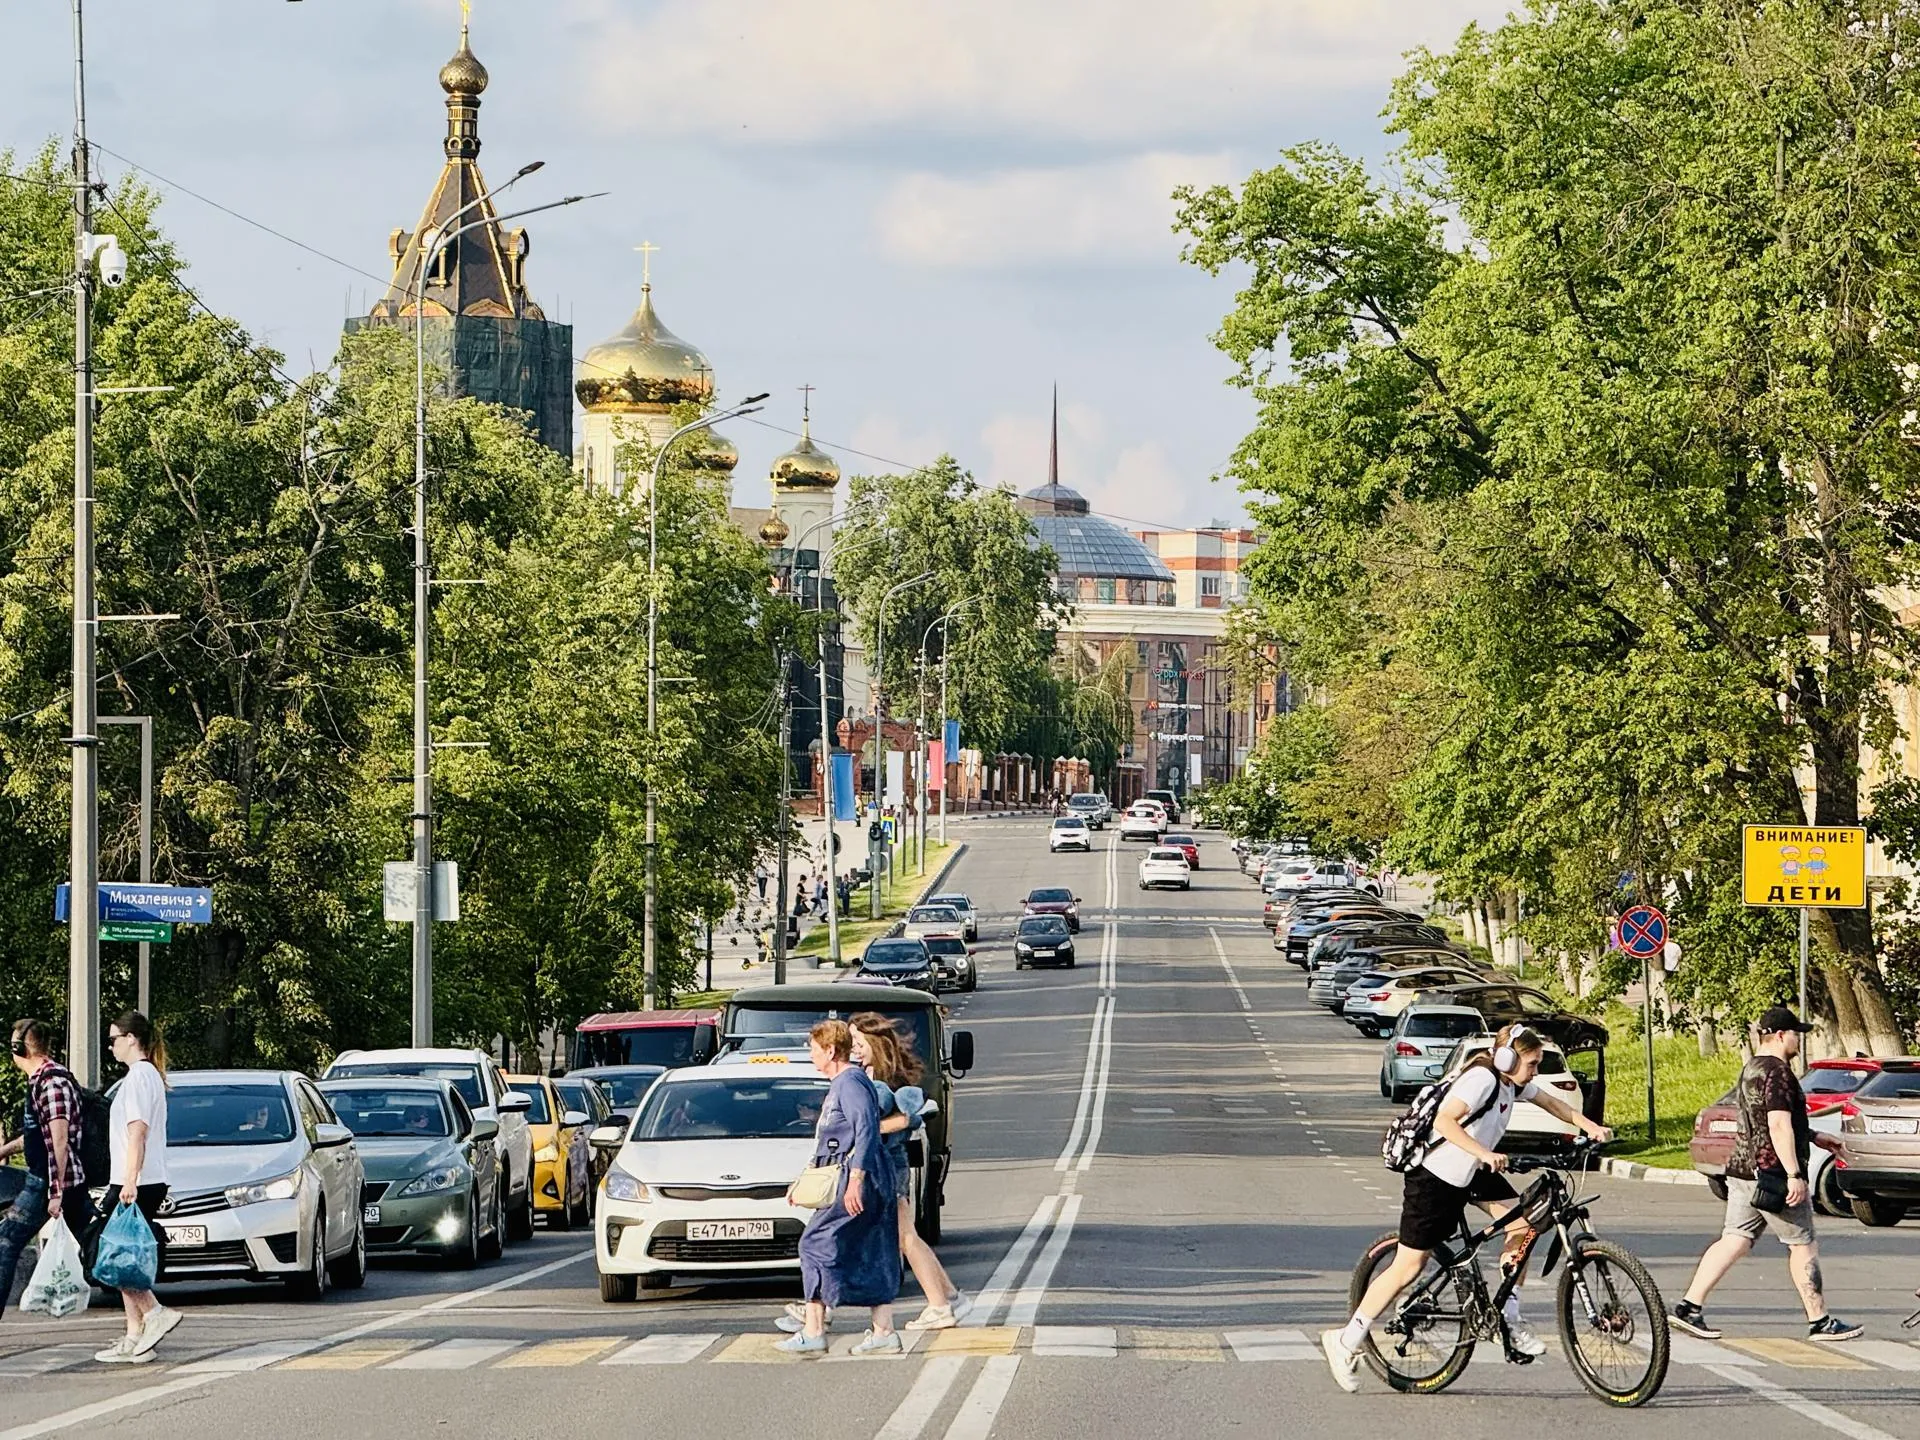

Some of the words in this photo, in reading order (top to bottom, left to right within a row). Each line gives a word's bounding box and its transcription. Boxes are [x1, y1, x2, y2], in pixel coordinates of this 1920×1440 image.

[1756, 830, 1854, 843] ВНИМАНИЕ!
[109, 891, 193, 906] Михалевича
[1767, 886, 1841, 902] ДЕТИ
[160, 909, 191, 919] улица
[181, 1228, 201, 1239] 750
[748, 1222, 769, 1233] 790
